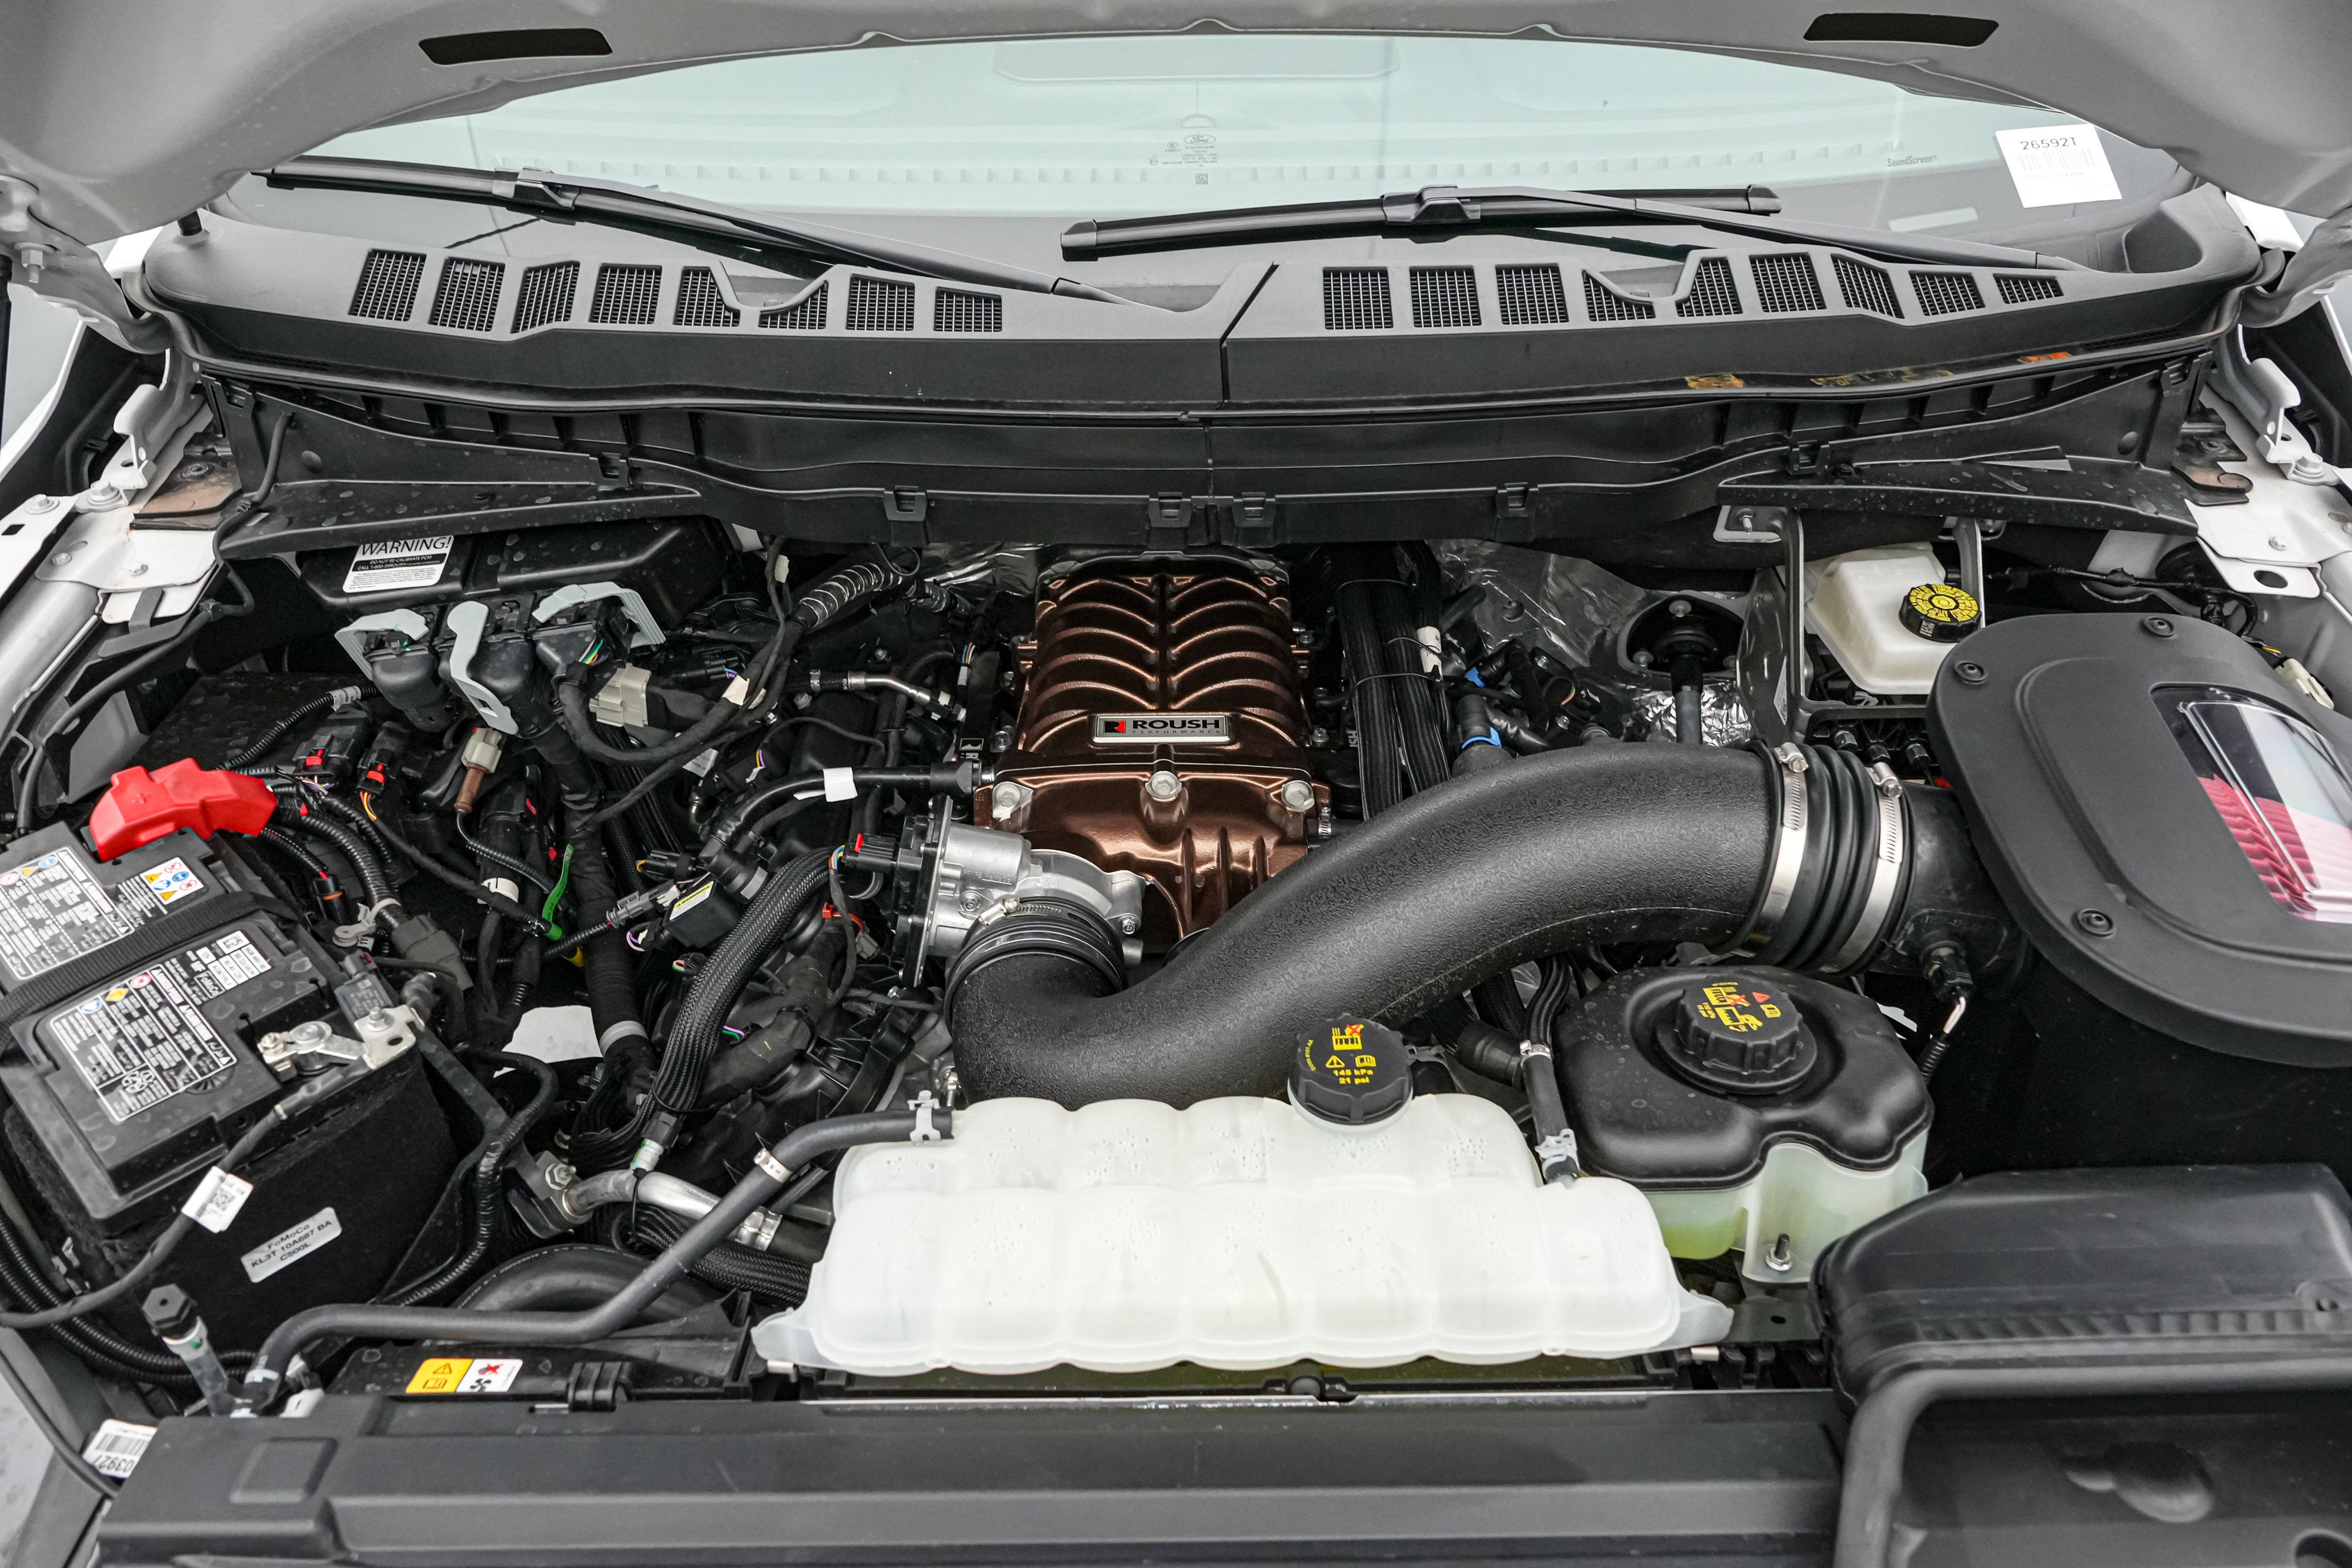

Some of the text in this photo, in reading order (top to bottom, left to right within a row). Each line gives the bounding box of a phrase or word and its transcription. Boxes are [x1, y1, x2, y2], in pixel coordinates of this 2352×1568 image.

[2020, 137, 2076, 150] 26592T
[1887, 155, 1933, 167] SoundScreen
[362, 536, 452, 556] WARNING!
[1132, 720, 1220, 729] ROUSH
[1354, 1076, 1369, 1085] psi
[268, 1224, 309, 1250] FoMoCo
